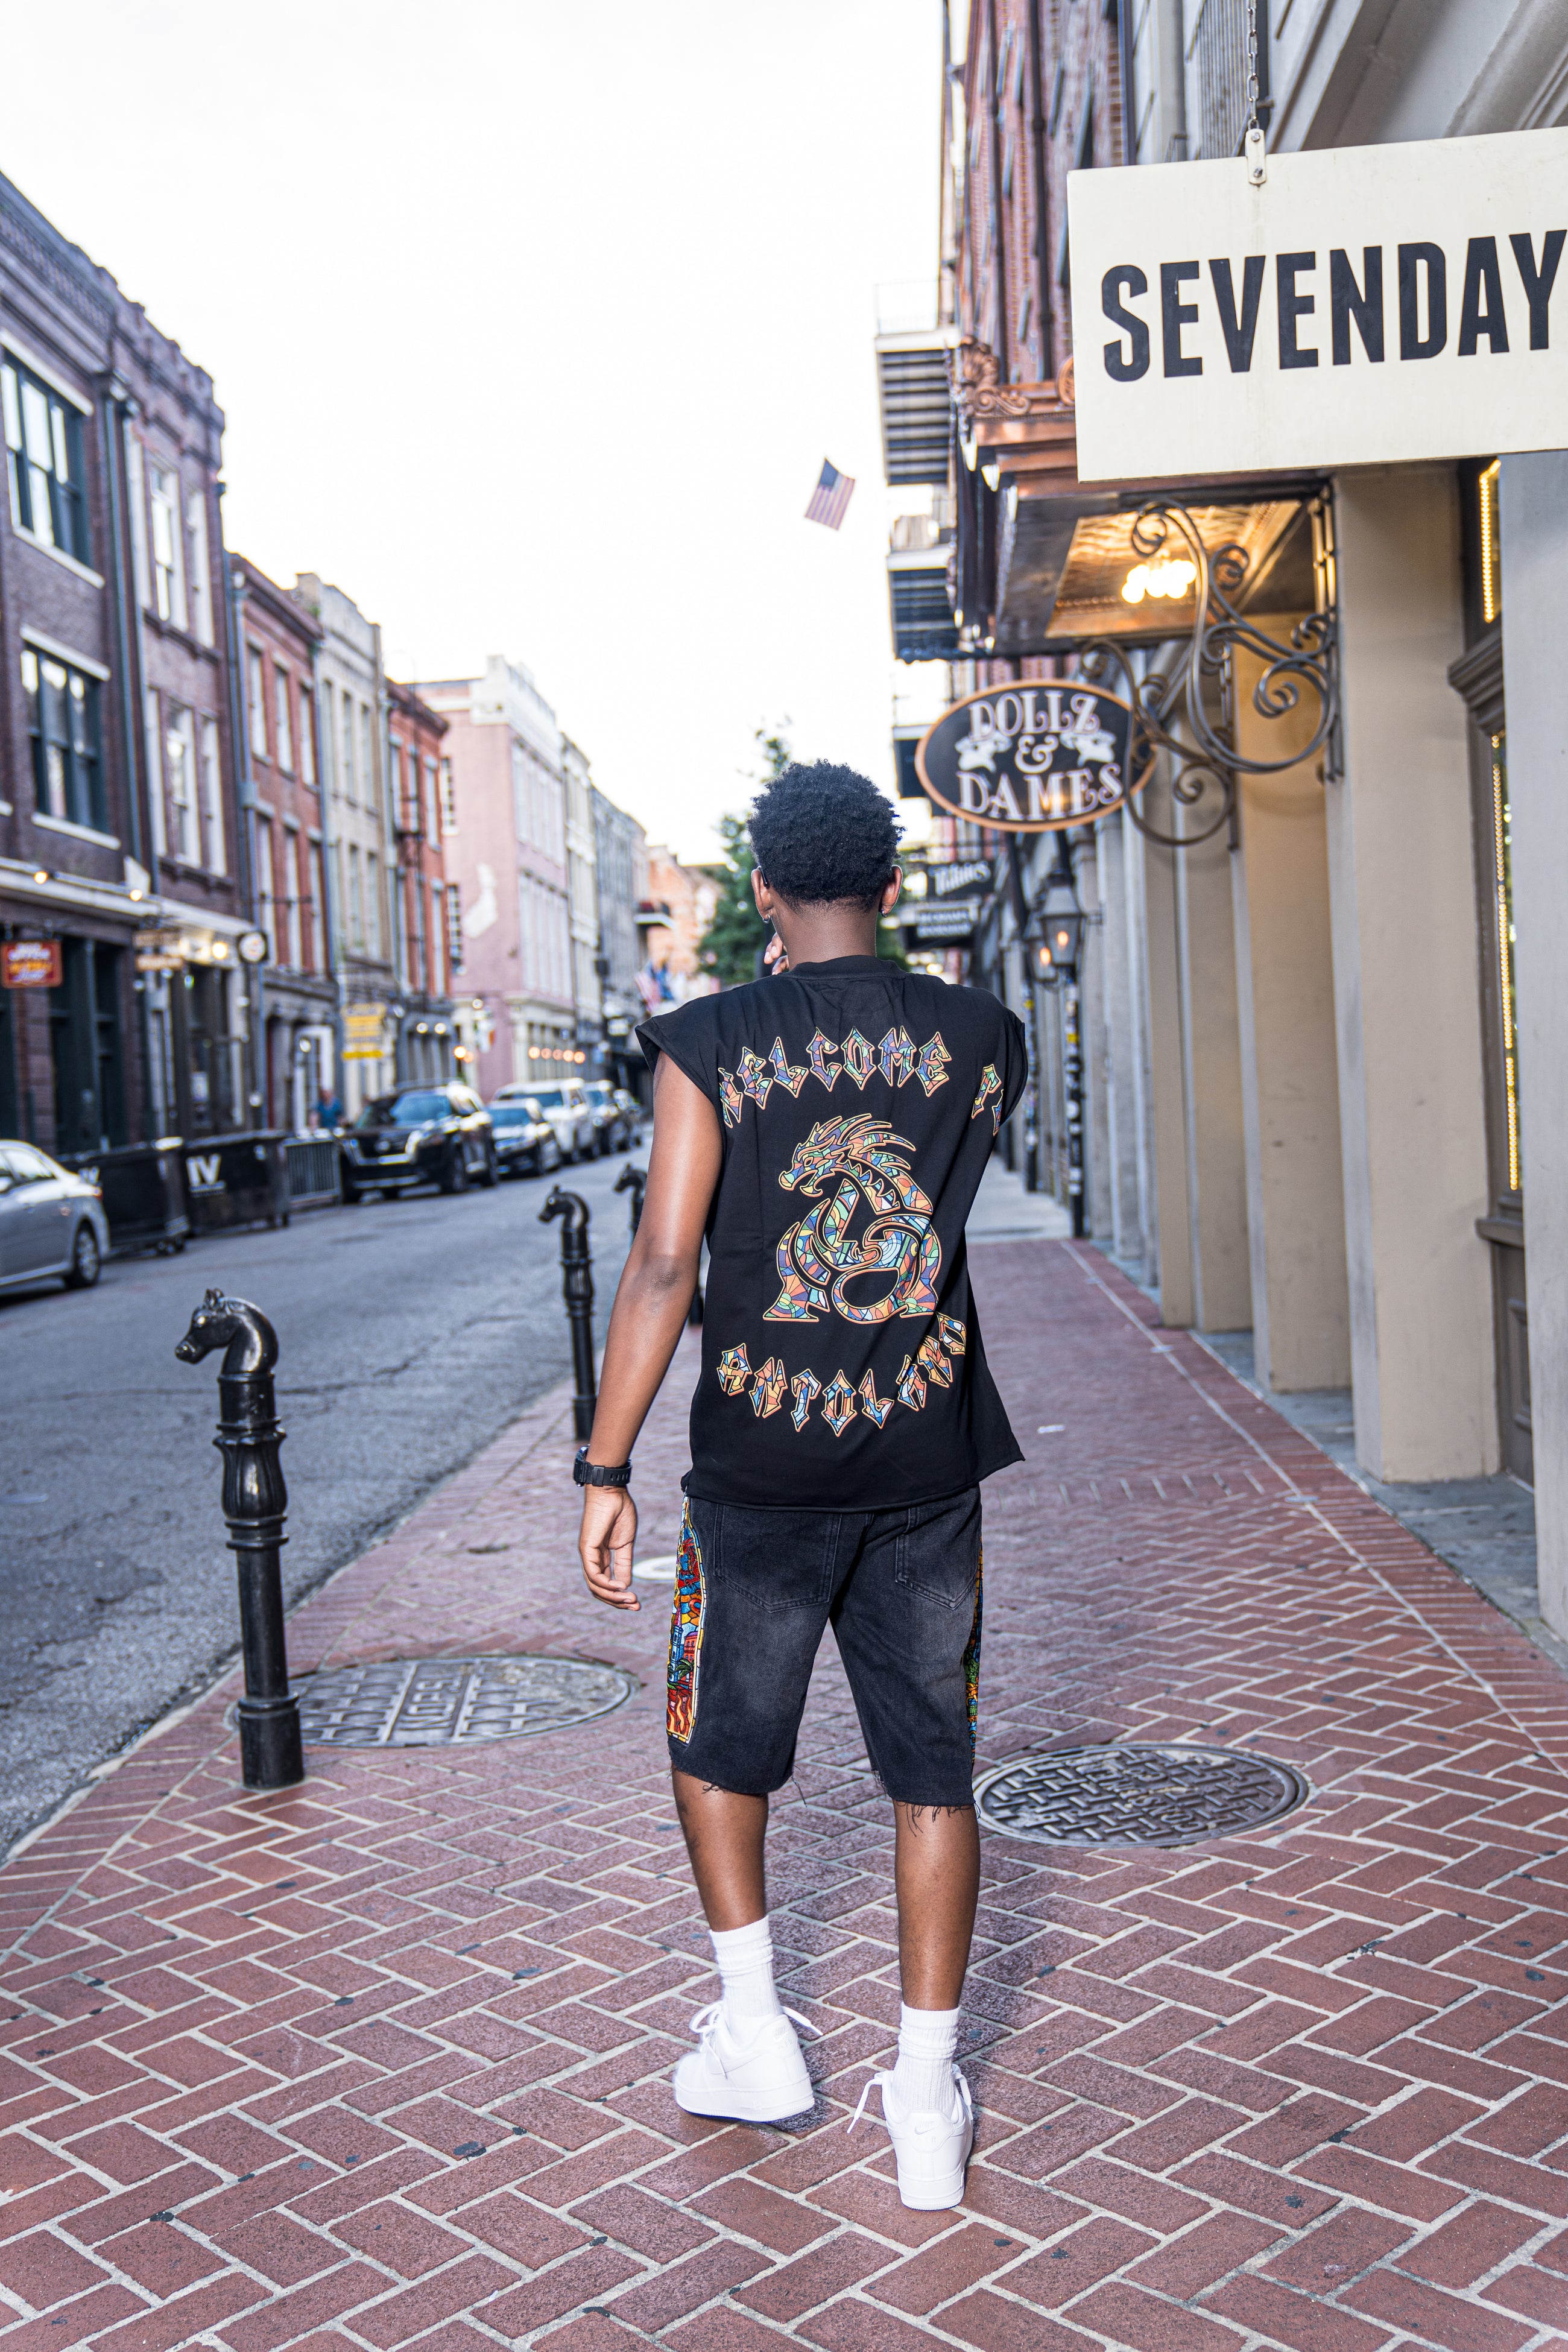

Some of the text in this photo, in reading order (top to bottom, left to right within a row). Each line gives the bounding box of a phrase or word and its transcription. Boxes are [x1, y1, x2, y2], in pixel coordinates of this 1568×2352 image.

[1102, 230, 1568, 382] SEVENDAY
[969, 690, 1099, 741] DOLLZ
[1014, 735, 1058, 774] &
[956, 763, 1124, 821] DAMES
[718, 1025, 952, 1128] WELCOME
